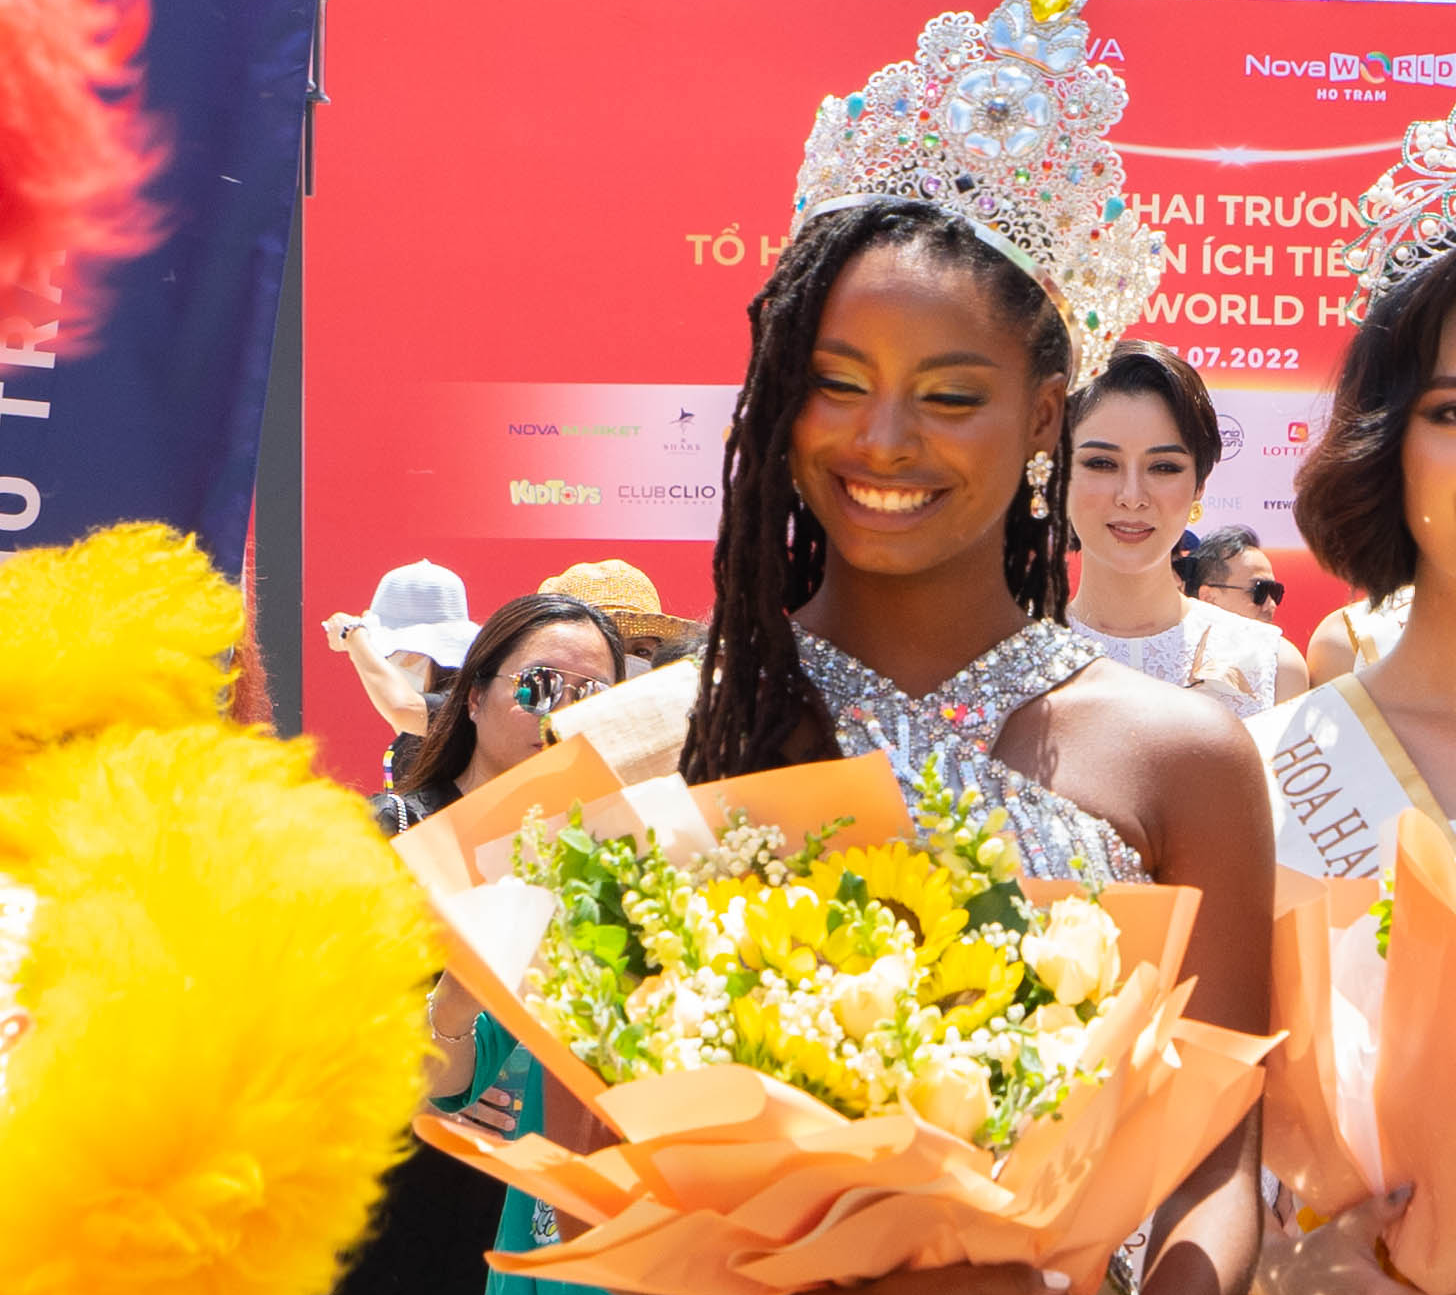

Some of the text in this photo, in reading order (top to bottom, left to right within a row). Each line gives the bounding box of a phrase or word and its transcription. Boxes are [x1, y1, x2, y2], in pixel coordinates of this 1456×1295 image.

[1316, 88, 1387, 101] HO TRAM
[1121, 193, 1205, 225] HAI
[685, 222, 745, 266] TỔ
[1202, 236, 1273, 276] ÍCH
[1286, 239, 1354, 277] TIÊ
[618, 485, 716, 498] CLUB CLIO
[1271, 733, 1344, 826] HOA
